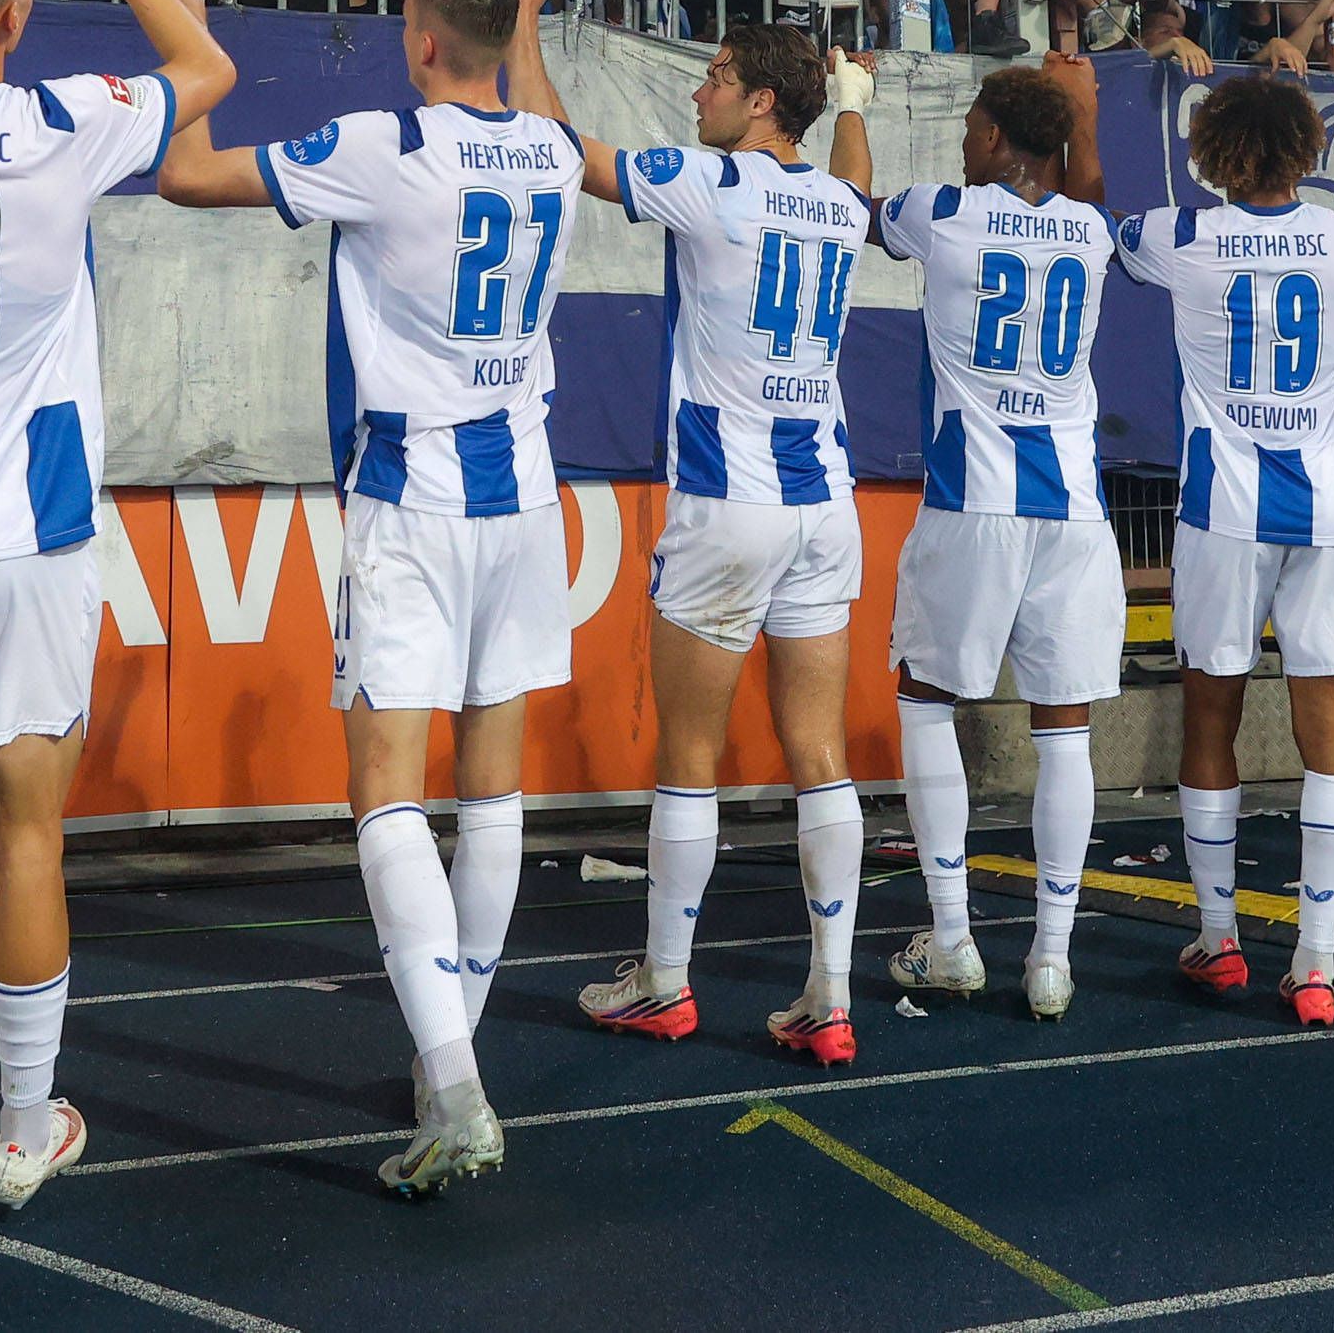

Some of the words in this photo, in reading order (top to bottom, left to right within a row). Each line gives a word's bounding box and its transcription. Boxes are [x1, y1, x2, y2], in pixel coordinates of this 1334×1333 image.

[459, 141, 531, 171] HERTHA
[533, 142, 560, 171] BSC
[653, 153, 664, 167] OF
[765, 190, 827, 224] HERTHA
[831, 201, 856, 228] BSC
[987, 211, 1059, 241] HERTHA
[1062, 219, 1091, 245] BSC
[1216, 232, 1291, 259] HERTHA
[1295, 233, 1328, 258] BSC
[747, 227, 856, 365] 44
[968, 247, 1092, 381] 20
[1222, 269, 1324, 398] 19
[470, 356, 529, 387] KOLBE
[761, 373, 830, 406] GECHTER
[995, 388, 1046, 417] ALFA
[1225, 402, 1318, 432] ADEWUMI
